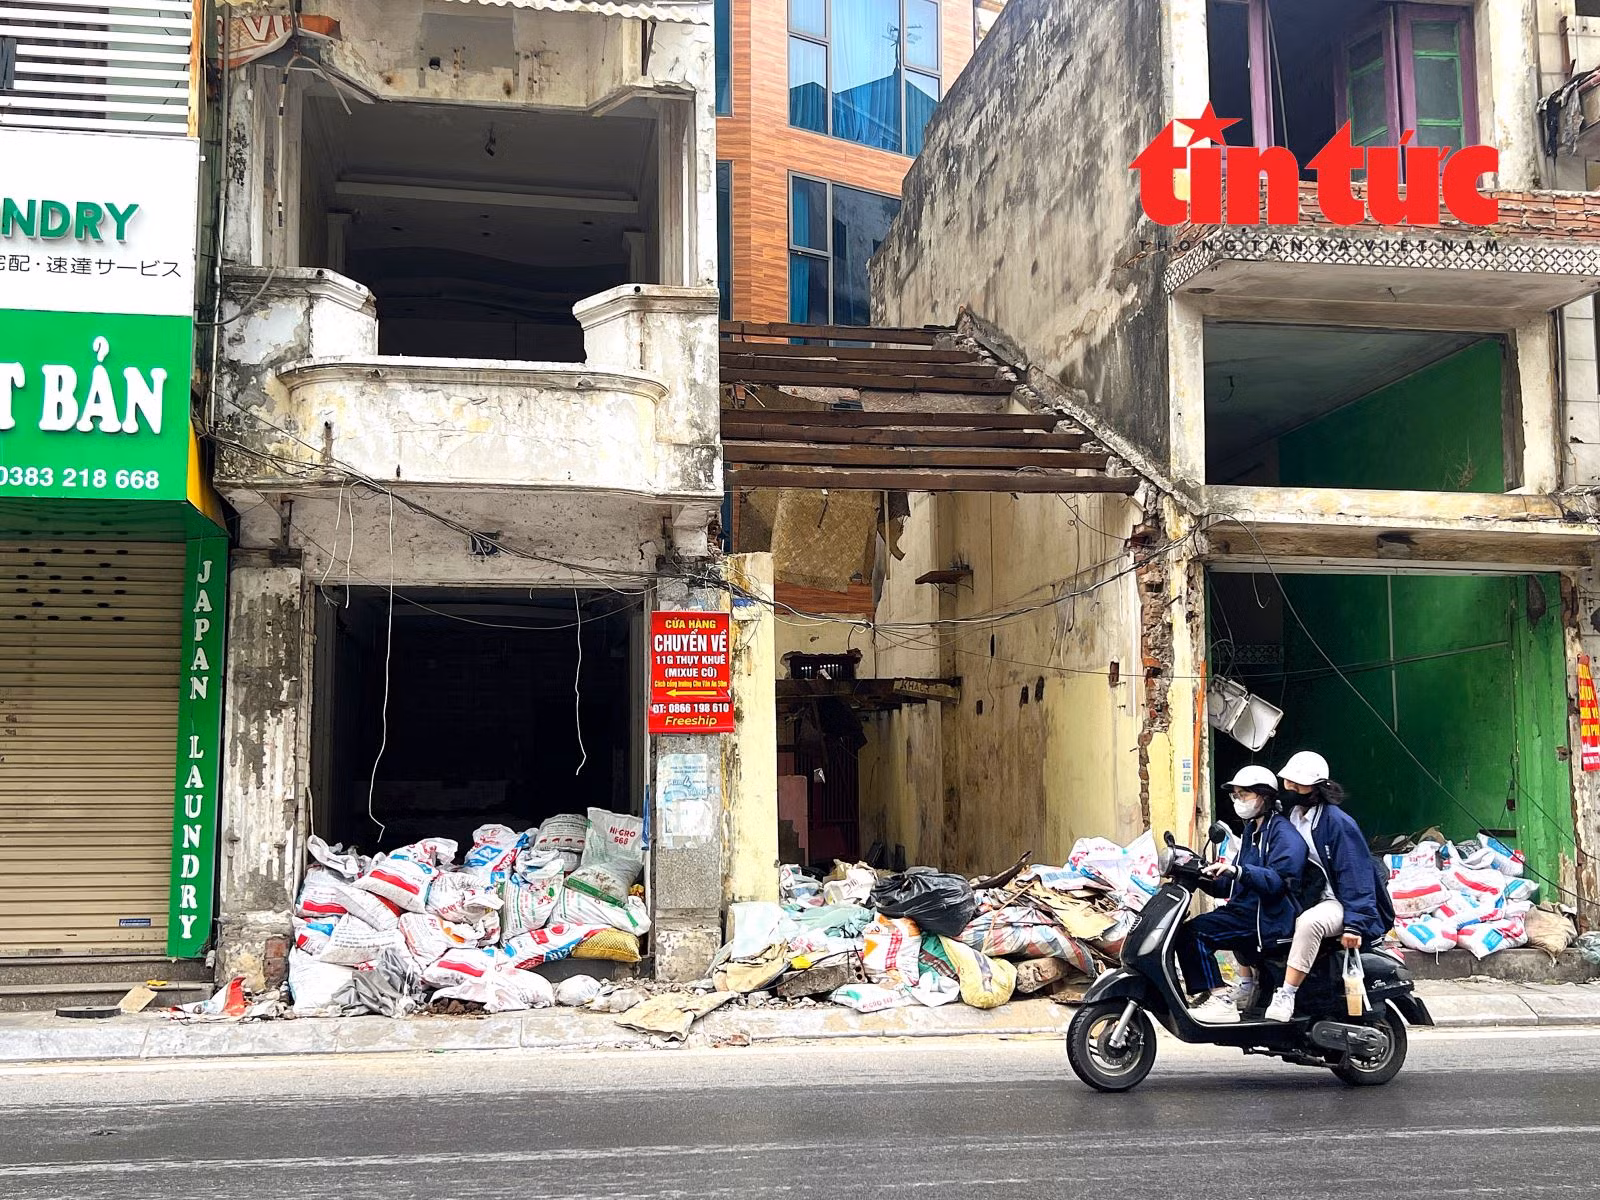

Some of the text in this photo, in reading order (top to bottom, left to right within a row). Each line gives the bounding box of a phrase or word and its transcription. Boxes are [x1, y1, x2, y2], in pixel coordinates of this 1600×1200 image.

[1, 197, 140, 242] NDRY
[0, 254, 182, 278] 配・速達サービス
[39, 336, 167, 434] BẢN
[0, 466, 160, 490] 0383 218 668
[189, 560, 213, 700] JAPAN
[665, 617, 716, 629] CỬA HÀNG
[654, 629, 727, 652] CHUYỂN VỀ
[656, 653, 726, 666] 11G THỤY KHUÊ
[664, 666, 717, 678] (MIXUE CŨ)
[668, 703, 691, 713] 0866
[693, 703, 710, 713] 198
[712, 703, 729, 713] 610
[665, 715, 718, 726] Freeship
[178, 735, 204, 939] LAUNDRY
